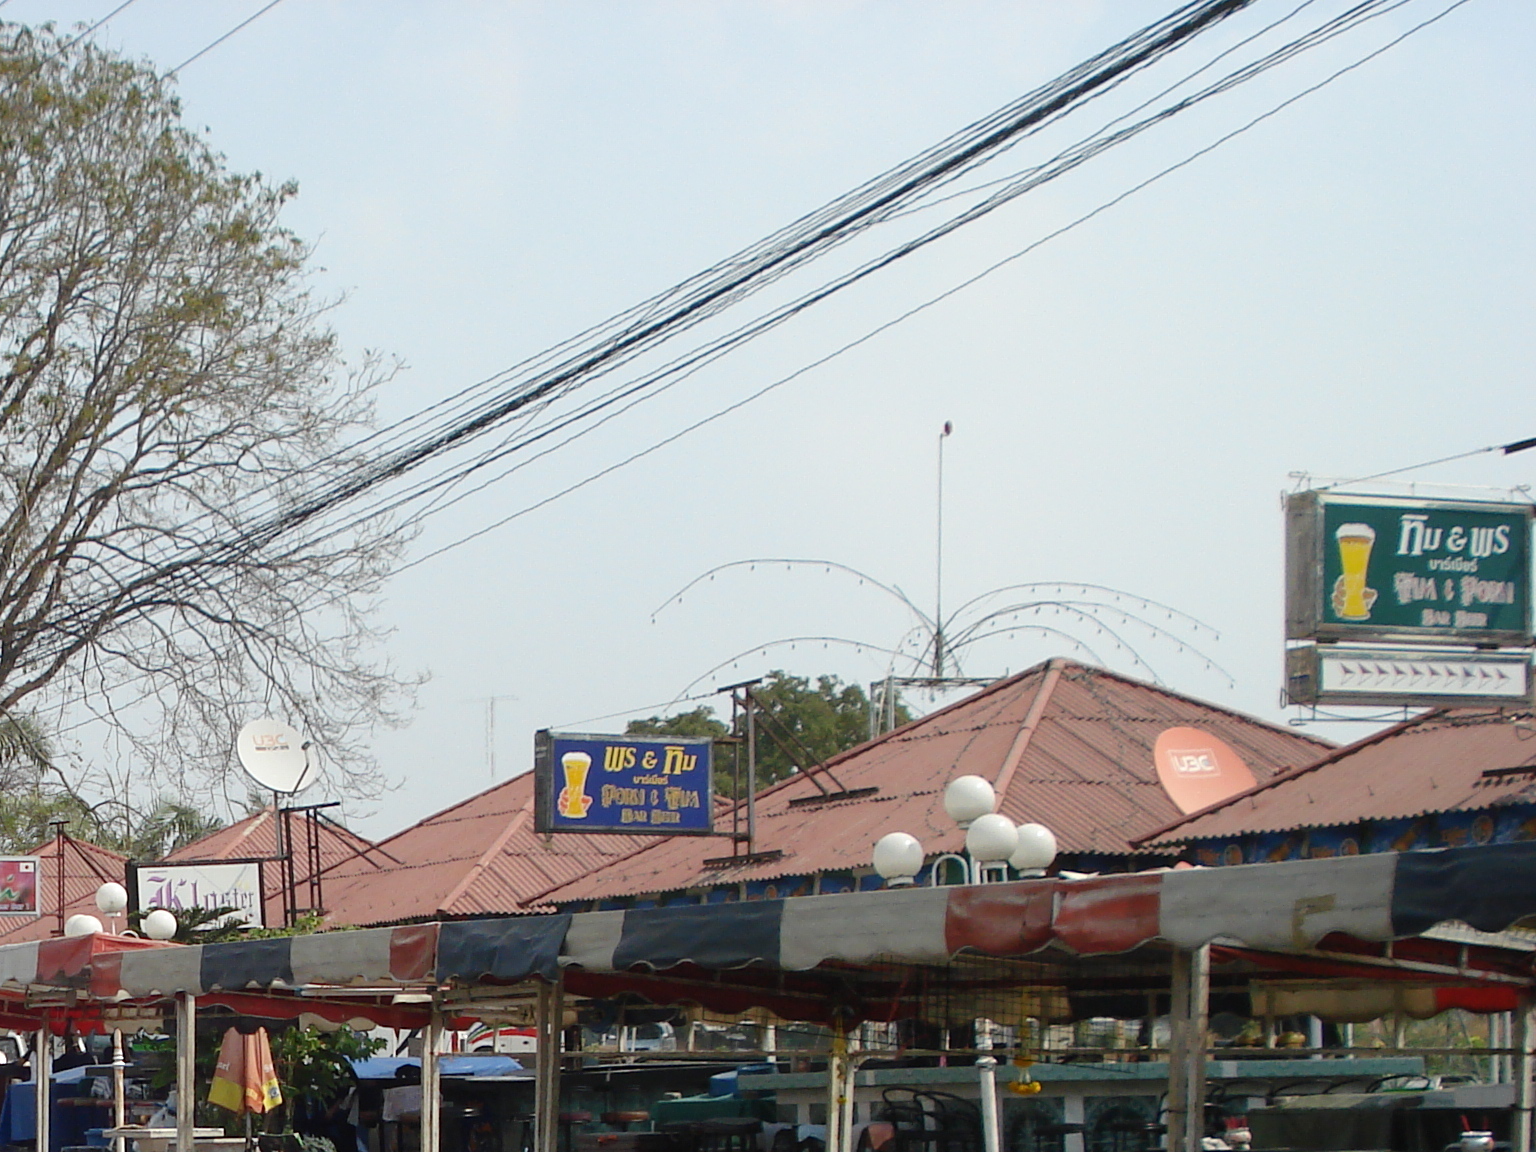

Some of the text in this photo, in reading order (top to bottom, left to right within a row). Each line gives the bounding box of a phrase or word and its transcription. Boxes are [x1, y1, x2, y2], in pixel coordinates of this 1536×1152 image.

[1447, 526, 1467, 552] &
[1470, 525, 1511, 558] พร
[252, 733, 289, 747] UBC
[604, 746, 637, 772] พร
[642, 751, 658, 770] &
[1174, 755, 1215, 773] UBC
[147, 876, 254, 912] Kloster
